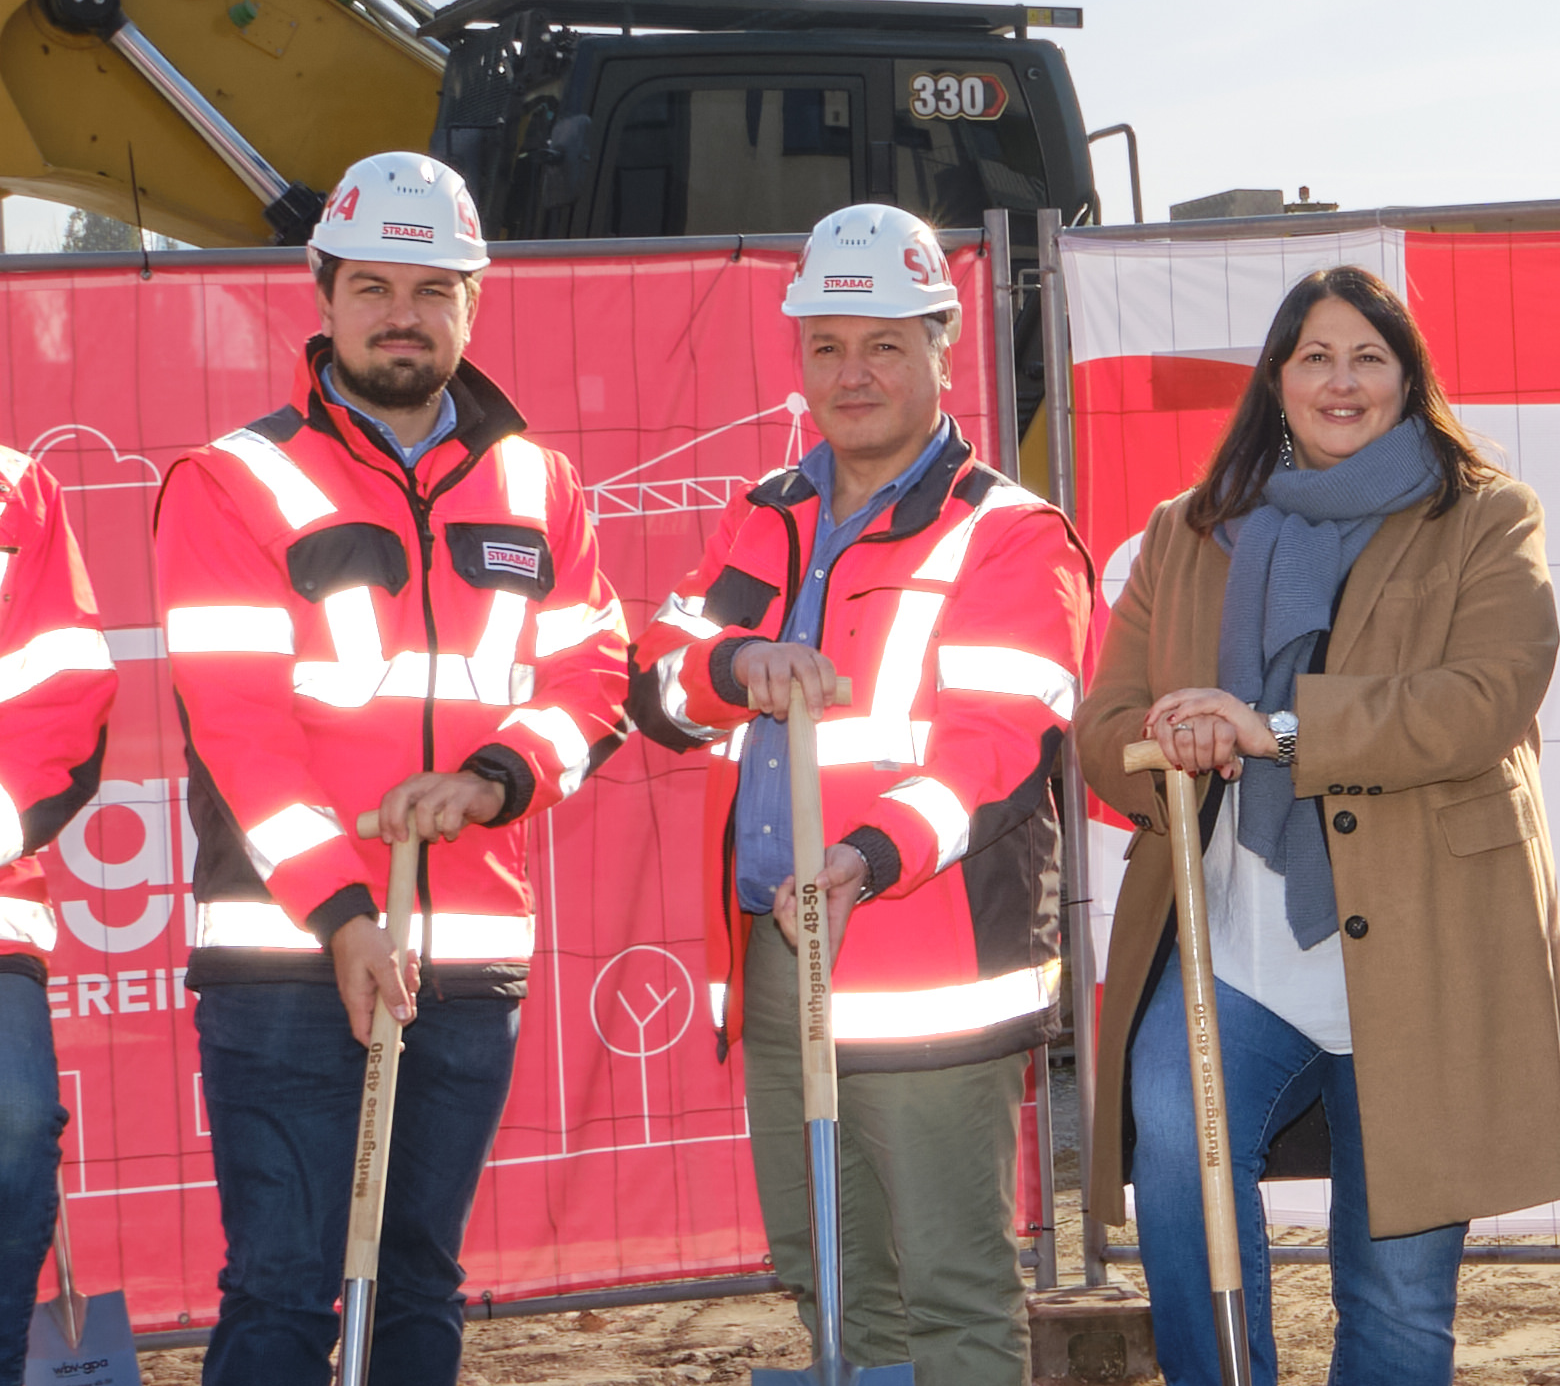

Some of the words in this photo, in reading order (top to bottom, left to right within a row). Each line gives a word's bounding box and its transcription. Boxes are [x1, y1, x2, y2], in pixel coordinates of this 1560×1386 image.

[913, 76, 984, 115] 330
[382, 226, 434, 240] STRABAG
[824, 279, 874, 289] STRABAG
[487, 550, 536, 568] STRABAG
[802, 883, 819, 934] 48-50
[808, 939, 826, 1042] Muthgasse
[354, 1097, 377, 1198] Muthgasse
[366, 1041, 384, 1092] 48-50
[1202, 1062, 1220, 1168] Muthgasse
